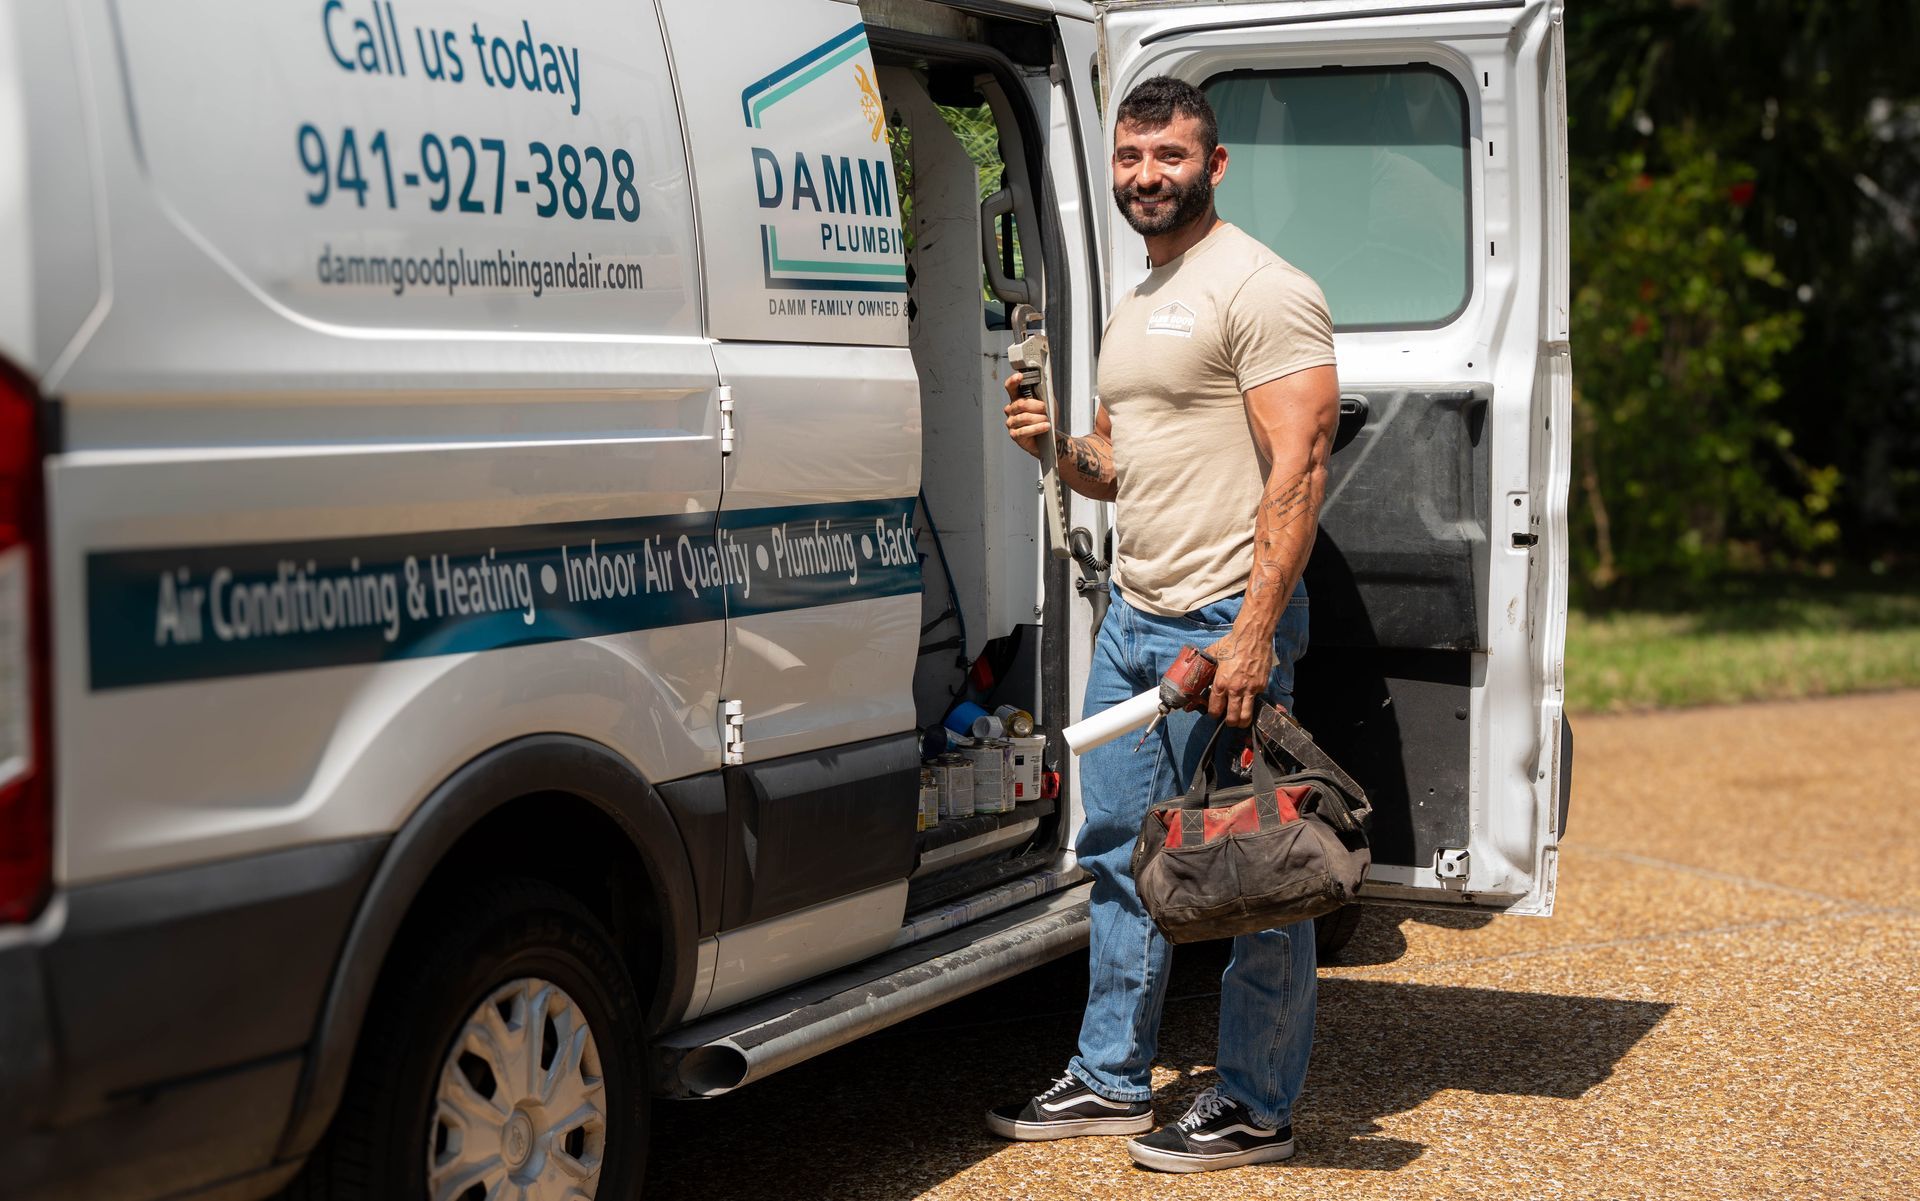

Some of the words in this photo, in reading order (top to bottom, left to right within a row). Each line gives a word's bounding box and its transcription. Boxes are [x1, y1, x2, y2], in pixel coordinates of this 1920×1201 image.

[322, 0, 406, 76] Call
[415, 26, 464, 83] us
[471, 19, 581, 116] today
[297, 122, 641, 223] 941-927-3828
[751, 147, 892, 218] DAMM
[317, 244, 644, 297] dammgoodplumbingandair.com
[769, 298, 806, 316] DAMM
[811, 299, 853, 316] FAMILY
[857, 301, 899, 317] OWNED
[562, 538, 637, 603] Indoor
[644, 534, 675, 594] Air
[677, 529, 751, 599] Quality
[771, 521, 858, 586] Plumbing
[875, 512, 917, 567] Back
[155, 567, 206, 645] Air
[209, 557, 399, 641] Conditioning
[404, 554, 430, 620] &
[430, 547, 536, 625] Heating
